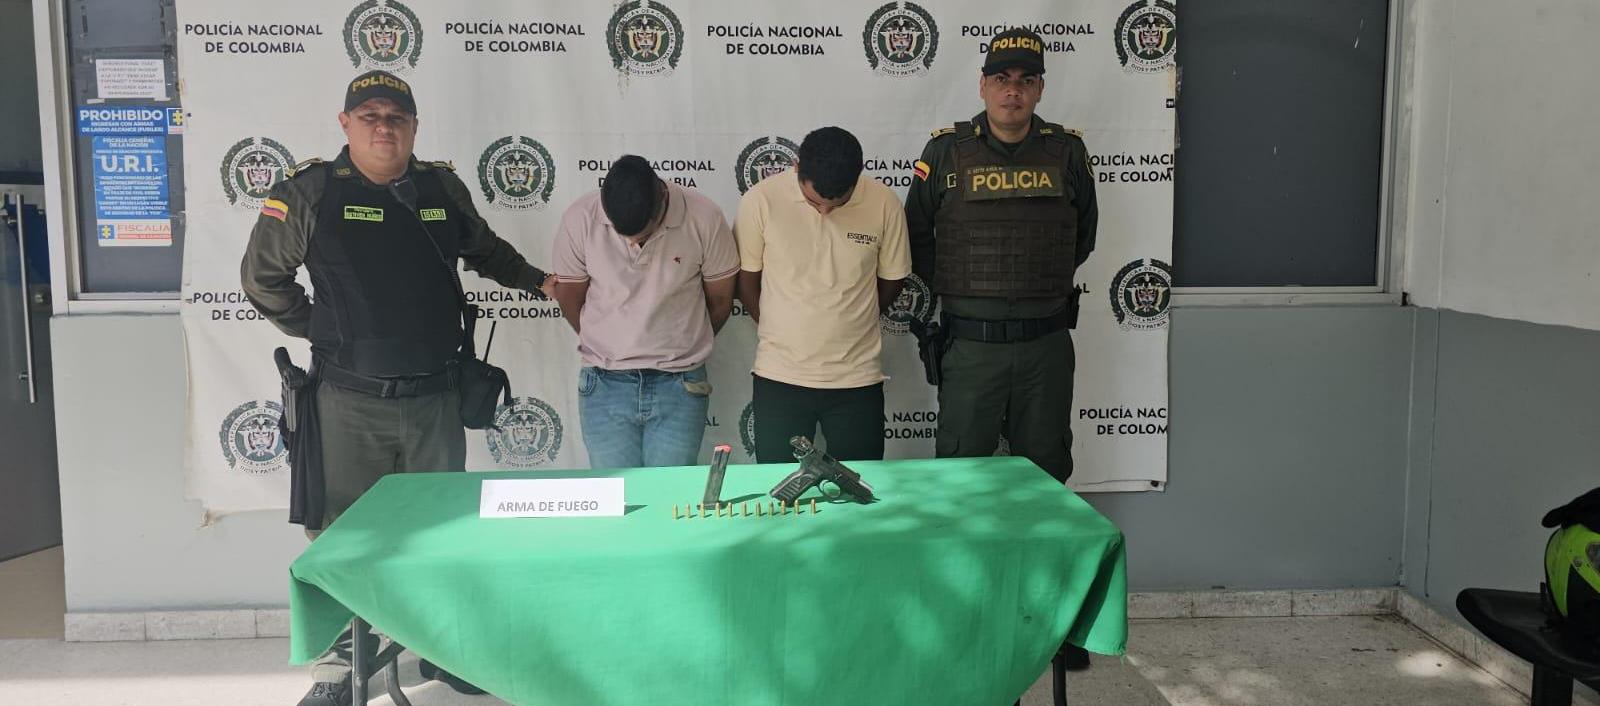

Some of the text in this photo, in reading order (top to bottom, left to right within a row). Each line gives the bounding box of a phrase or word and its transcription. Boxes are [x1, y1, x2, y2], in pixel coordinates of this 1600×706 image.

[185, 20, 323, 36] POLICÍA NACIONAL
[445, 19, 585, 35] POLICÍA NACIONAL
[707, 22, 843, 38] POLICÍA NACIONAL
[205, 42, 305, 53] DE COLOMBIA
[465, 41, 566, 52] DE COLOMBIA
[726, 43, 824, 55] DE COLOMBIA
[992, 37, 1040, 53] POLICIA
[352, 75, 408, 94] POLICIA
[80, 110, 163, 120] PROHIBIDO
[101, 154, 159, 172] U.R.I.
[1090, 152, 1173, 166] OLICÍA NACI
[579, 160, 610, 171] POLI
[972, 171, 1053, 192] POLICIA
[1100, 171, 1172, 182] DE COLOM
[212, 310, 230, 320] DE
[477, 308, 560, 318] DE COLOMB
[893, 412, 936, 422] NACIO
[884, 428, 936, 439] OLOMBI
[1097, 424, 1167, 435] DE COLOM
[497, 500, 598, 512] ARMA DE FUEGO
